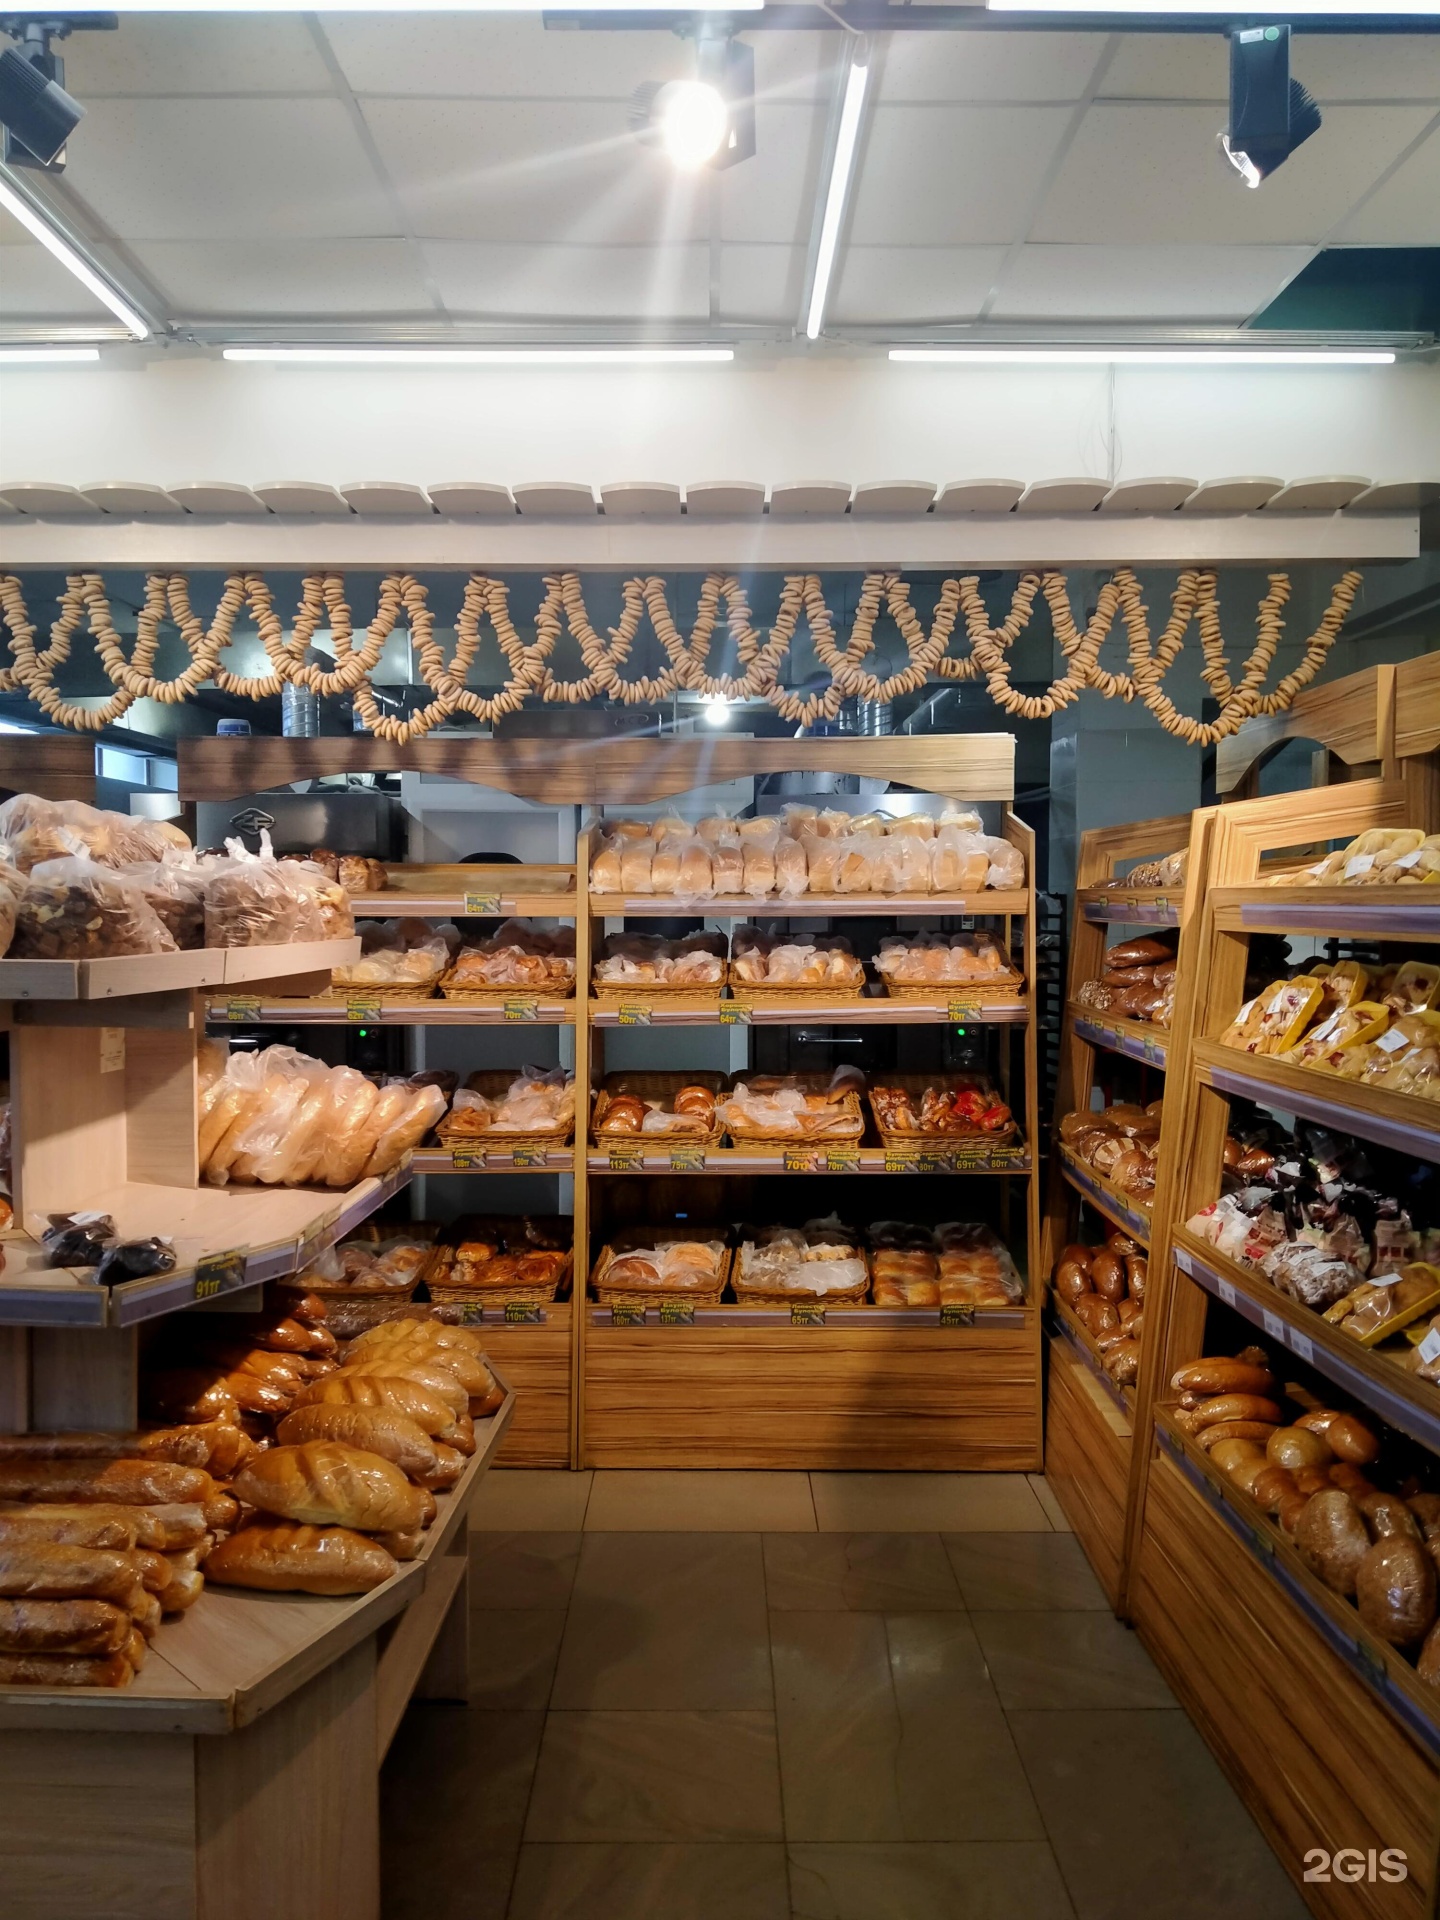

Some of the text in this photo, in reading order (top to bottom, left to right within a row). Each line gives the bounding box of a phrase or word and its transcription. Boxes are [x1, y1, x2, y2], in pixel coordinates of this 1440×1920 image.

[619, 1014, 636, 1024] 50тг
[949, 1011, 965, 1020] 70тг
[610, 1159, 629, 1170] 113тг
[828, 1161, 843, 1171] 70тг
[885, 1162, 905, 1172] 69тг
[956, 1160, 976, 1169] 69тг
[991, 1159, 1008, 1168] 80тг
[196, 1279, 221, 1299] 91тг
[505, 1312, 525, 1321] 110тг
[791, 1315, 808, 1325] 65тг
[941, 1316, 959, 1325] 45тг
